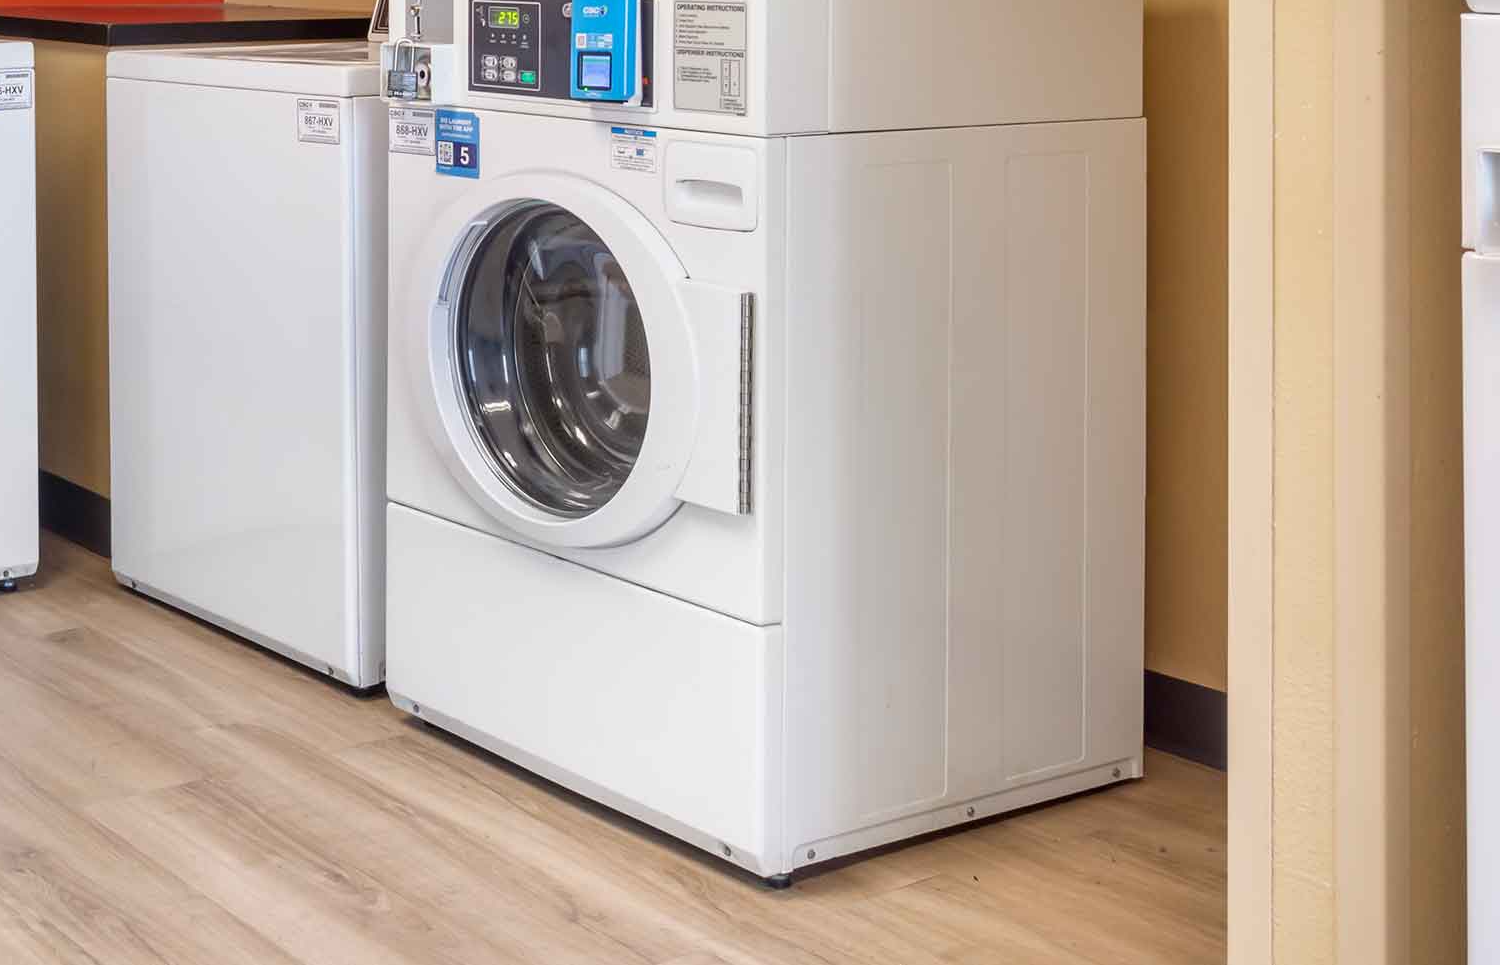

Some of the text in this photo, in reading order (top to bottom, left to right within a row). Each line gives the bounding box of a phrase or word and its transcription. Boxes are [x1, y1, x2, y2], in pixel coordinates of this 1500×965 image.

[676, 3, 745, 13] OPERATING INSTRUCTIONS
[460, 146, 470, 165] 5
